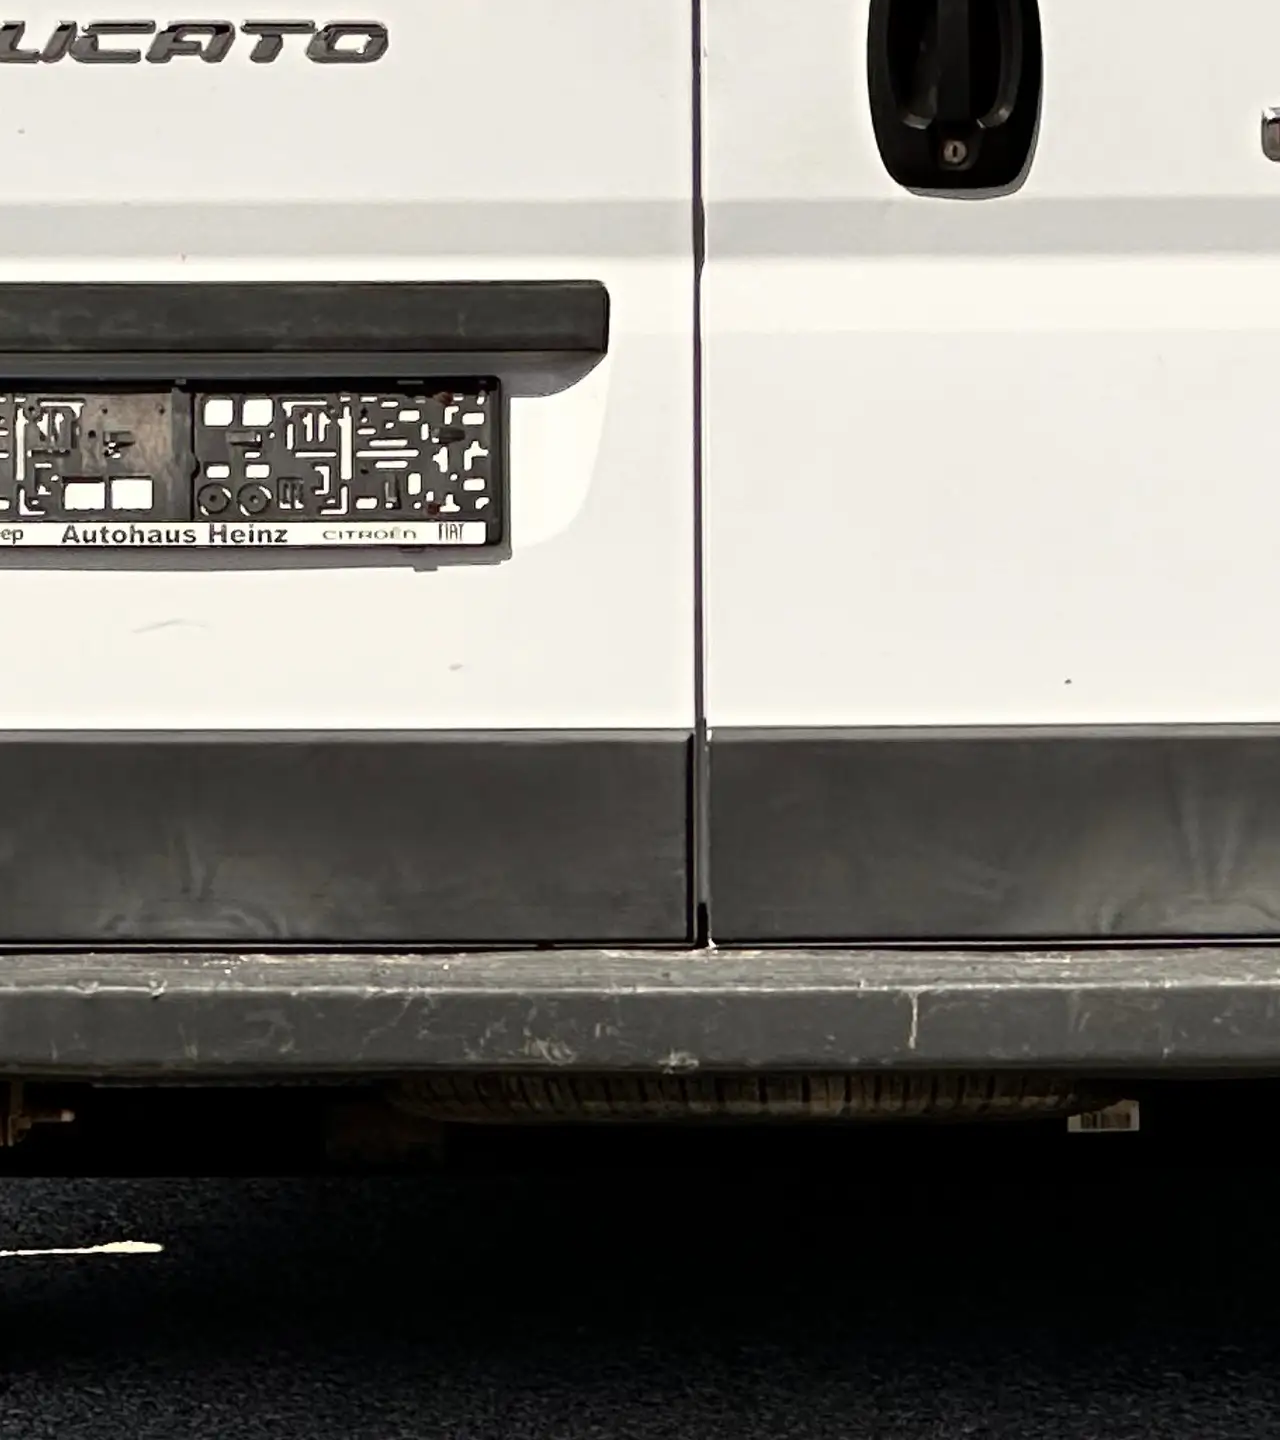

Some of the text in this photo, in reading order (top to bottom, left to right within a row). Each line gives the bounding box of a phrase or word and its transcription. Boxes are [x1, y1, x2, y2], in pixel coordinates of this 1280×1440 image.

[61, 525, 197, 544] Autohaus
[208, 524, 288, 544] Heinz
[438, 523, 464, 541] FIAT
